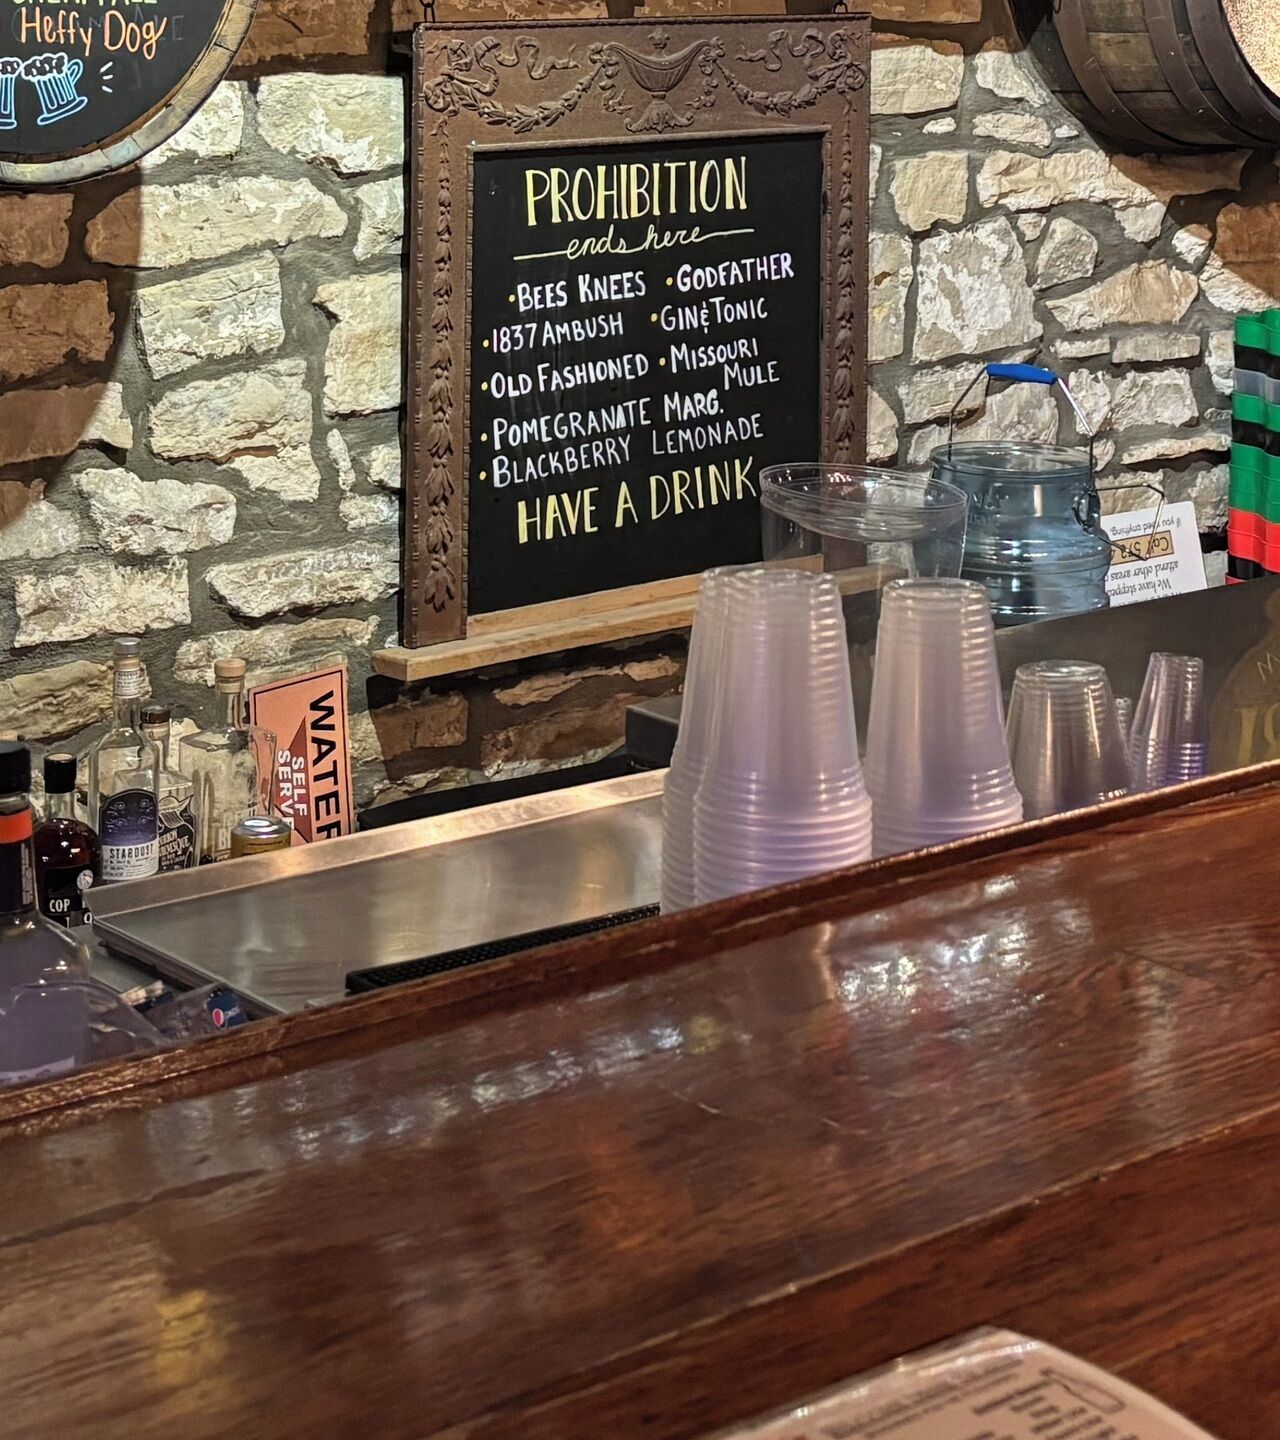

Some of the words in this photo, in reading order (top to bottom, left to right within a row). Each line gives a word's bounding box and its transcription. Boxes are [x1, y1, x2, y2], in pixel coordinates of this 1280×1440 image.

[20, 7, 94, 56] Heffy
[104, 10, 168, 60] Dog
[525, 156, 749, 226] PROHIBITION
[565, 224, 628, 260] ends
[629, 224, 712, 254] here
[518, 278, 568, 313] BEES
[578, 270, 646, 306] KNEES
[675, 252, 795, 292] GODFATHER
[492, 321, 538, 353] 1837
[541, 312, 624, 348] AMBUSH
[660, 304, 698, 332] GIN
[710, 297, 768, 330] TONIC
[490, 369, 532, 399] OLD
[536, 353, 649, 393] FASHIONED
[670, 337, 760, 374] MISSOURI
[723, 361, 780, 391] MULE
[492, 397, 651, 451] POMEGRANATE
[663, 388, 724, 424] MARG.
[491, 434, 631, 489] BLACKBERRY
[652, 413, 764, 456] LEMONADE
[517, 486, 599, 544] HAVE
[614, 481, 639, 529] A
[649, 456, 757, 521] DRINK
[291, 755, 307, 816] SELF
[309, 690, 341, 839] WATER
[109, 842, 156, 860] STARDUST
